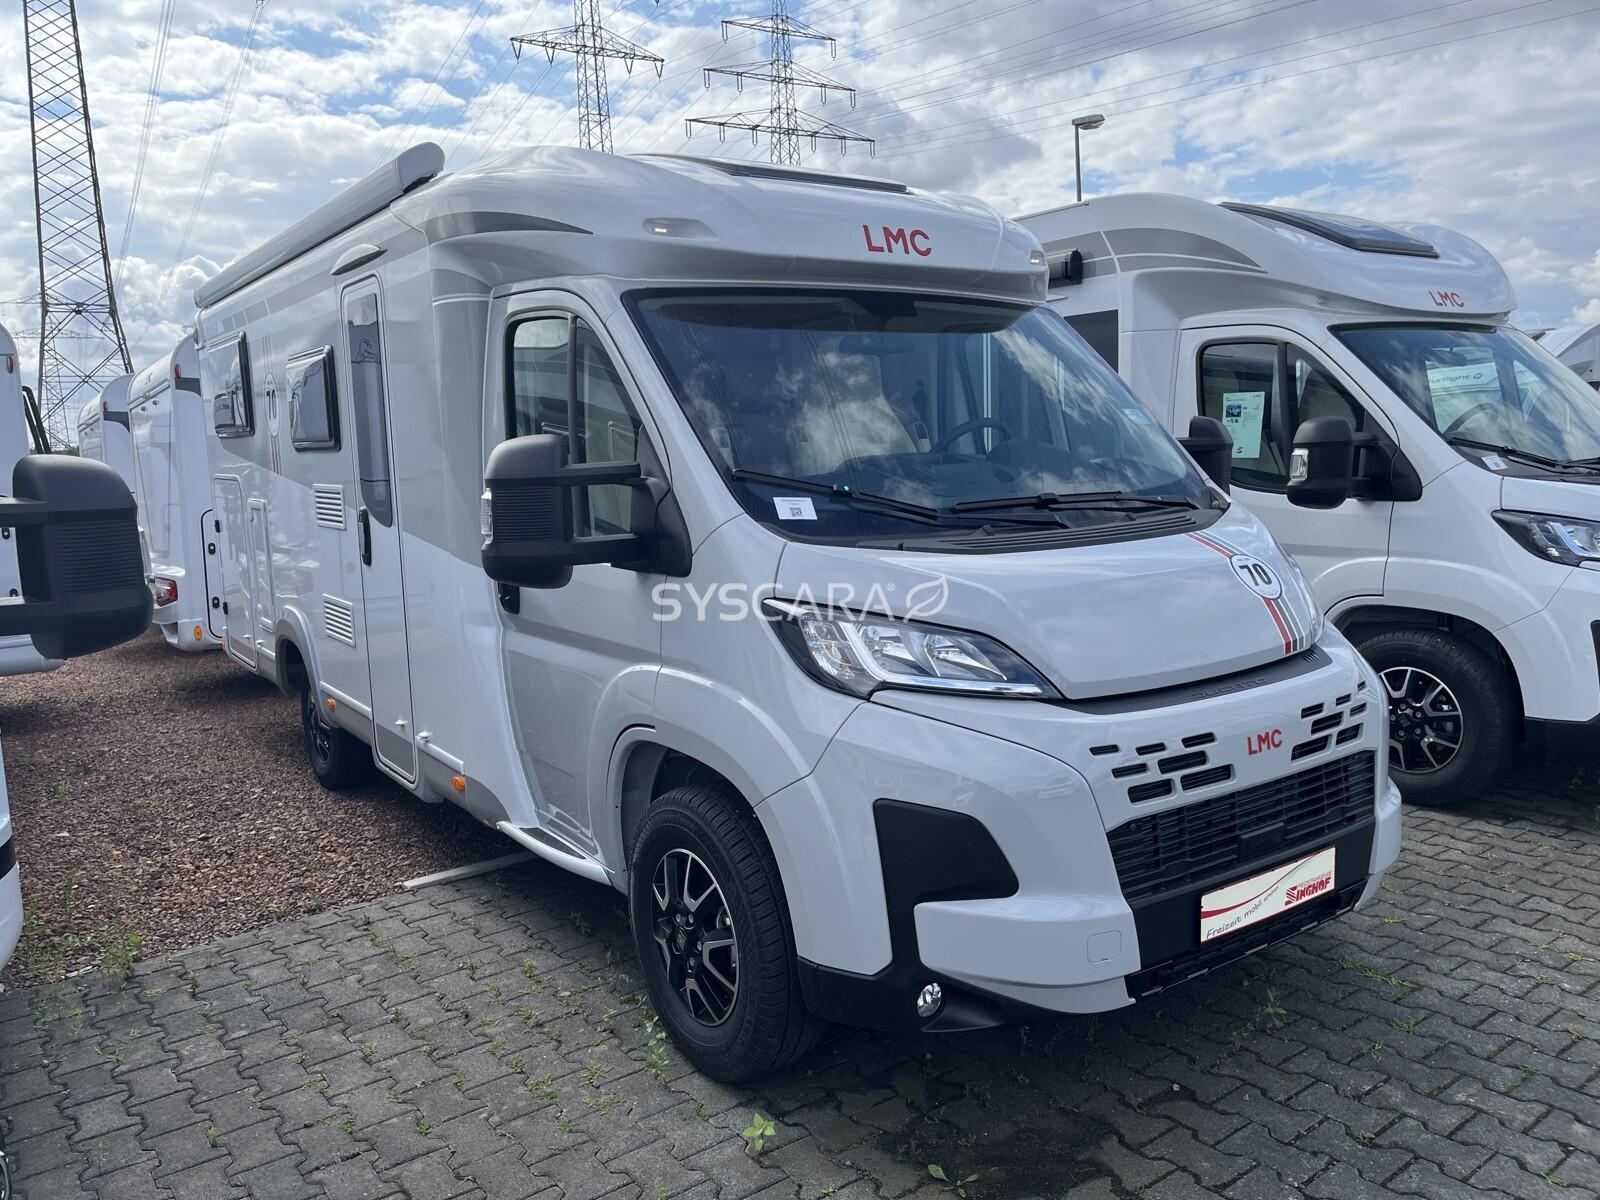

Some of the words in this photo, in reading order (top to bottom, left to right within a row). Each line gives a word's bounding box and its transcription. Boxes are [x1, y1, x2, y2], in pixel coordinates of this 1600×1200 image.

[863, 224, 932, 256] LMC
[1428, 290, 1464, 308] LMC
[1238, 563, 1273, 587] 70
[1247, 728, 1283, 756] LMC
[1206, 915, 1242, 940] Freizeit
[1243, 900, 1263, 919] mobil
